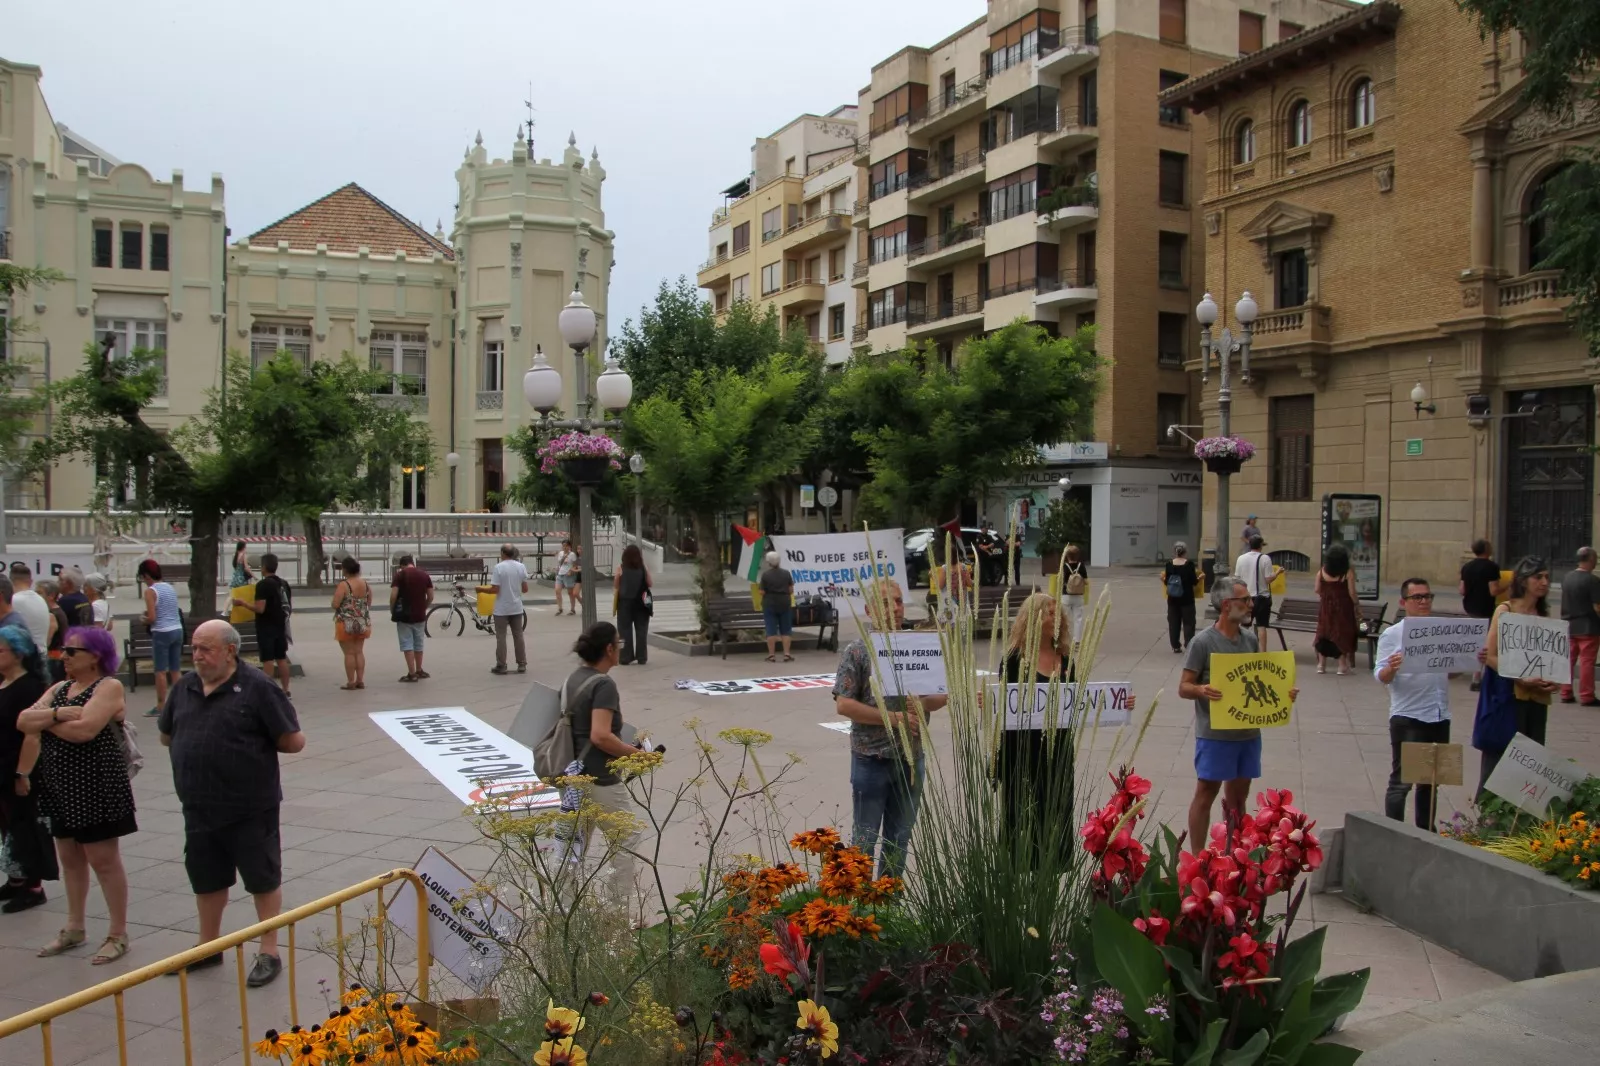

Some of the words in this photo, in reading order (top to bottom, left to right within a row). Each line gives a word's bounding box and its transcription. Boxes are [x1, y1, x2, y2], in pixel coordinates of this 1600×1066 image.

[1018, 471, 1073, 483] ITALDENT
[785, 549, 805, 563] NO
[814, 552, 845, 563] PUEDE
[852, 551, 869, 561] SER
[877, 549, 888, 559] E
[894, 663, 903, 671] ES
[905, 662, 930, 671] ILEGAL
[1226, 659, 1287, 682] BIENVENIDXS
[1427, 656, 1455, 668] CEUTA
[1228, 705, 1288, 725] REFUGIADXS
[395, 713, 484, 745] GUERRA
[419, 872, 475, 919] ALQUILEES
[428, 903, 490, 956] SOSTENIBLES
